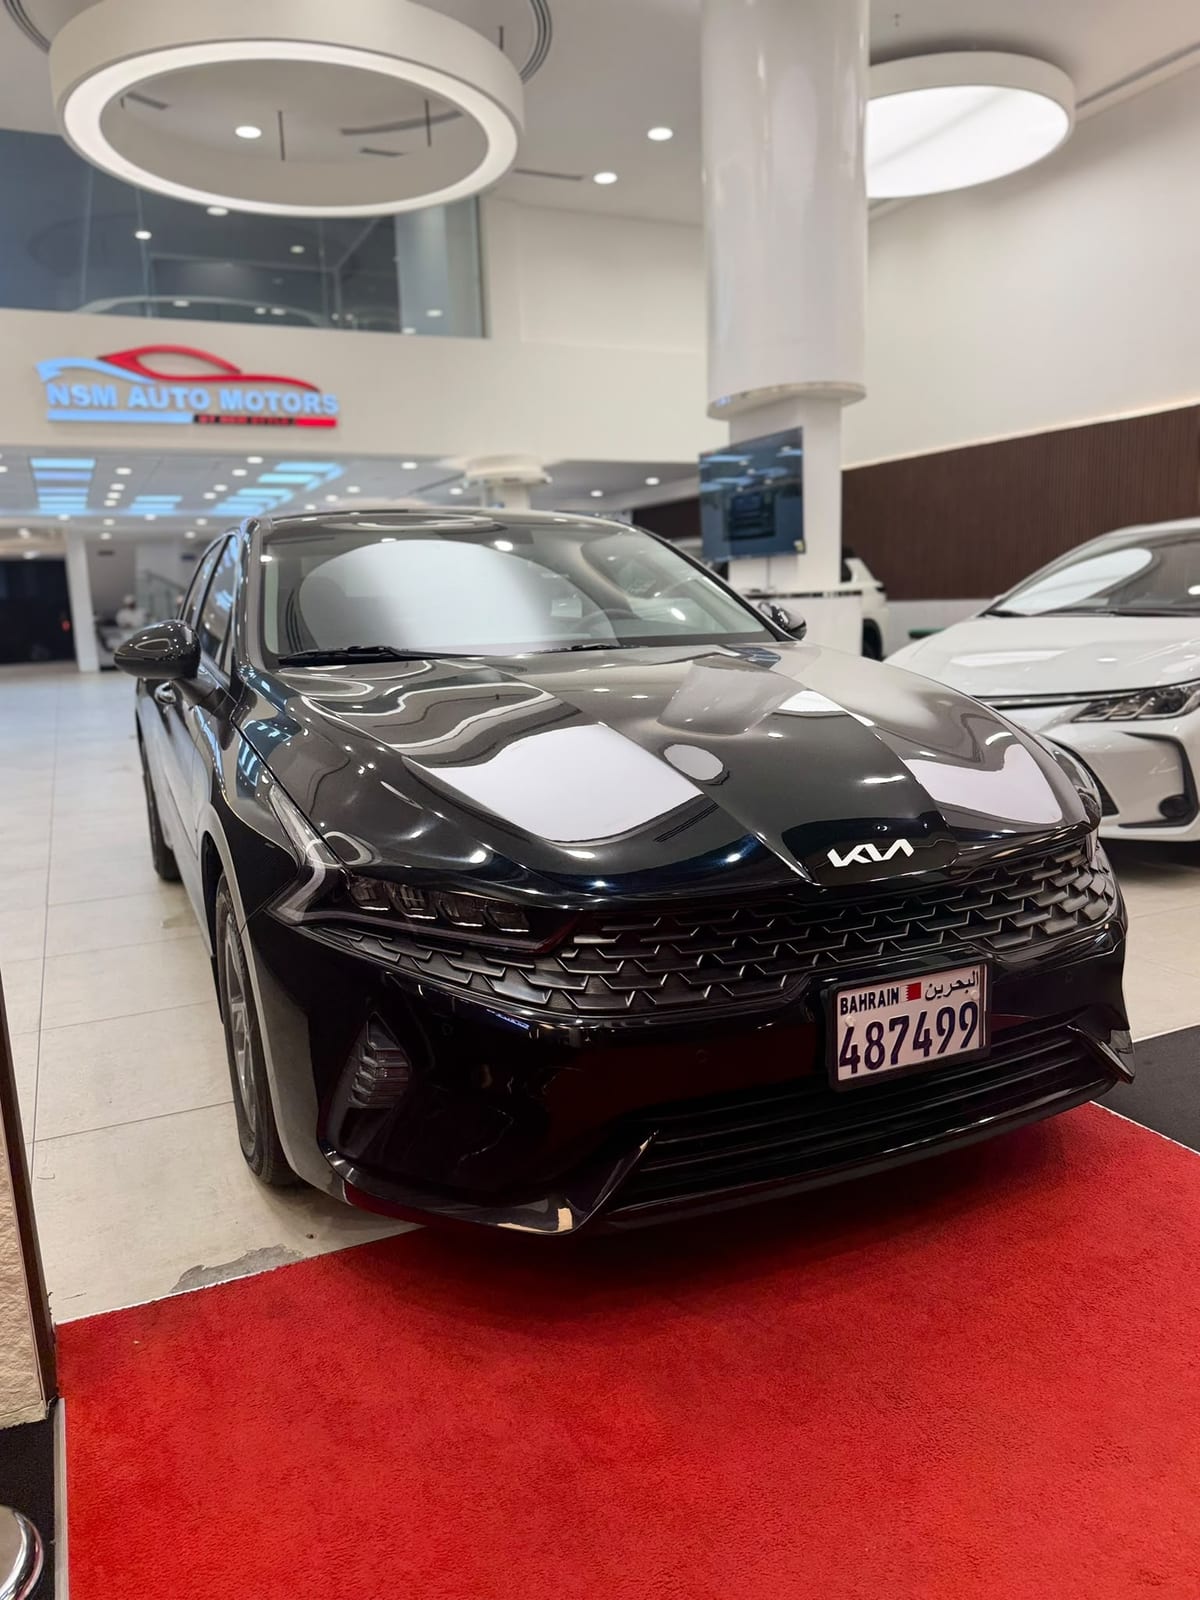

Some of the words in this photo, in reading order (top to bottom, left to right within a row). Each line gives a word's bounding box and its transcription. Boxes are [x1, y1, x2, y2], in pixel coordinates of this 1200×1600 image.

[47, 383, 117, 408] NSM
[128, 385, 211, 411] AUTO
[220, 388, 339, 414] MOTORS
[925, 970, 979, 1001] البحرين
[840, 987, 900, 1016] BAHRAIN
[839, 1001, 978, 1074] 487499
